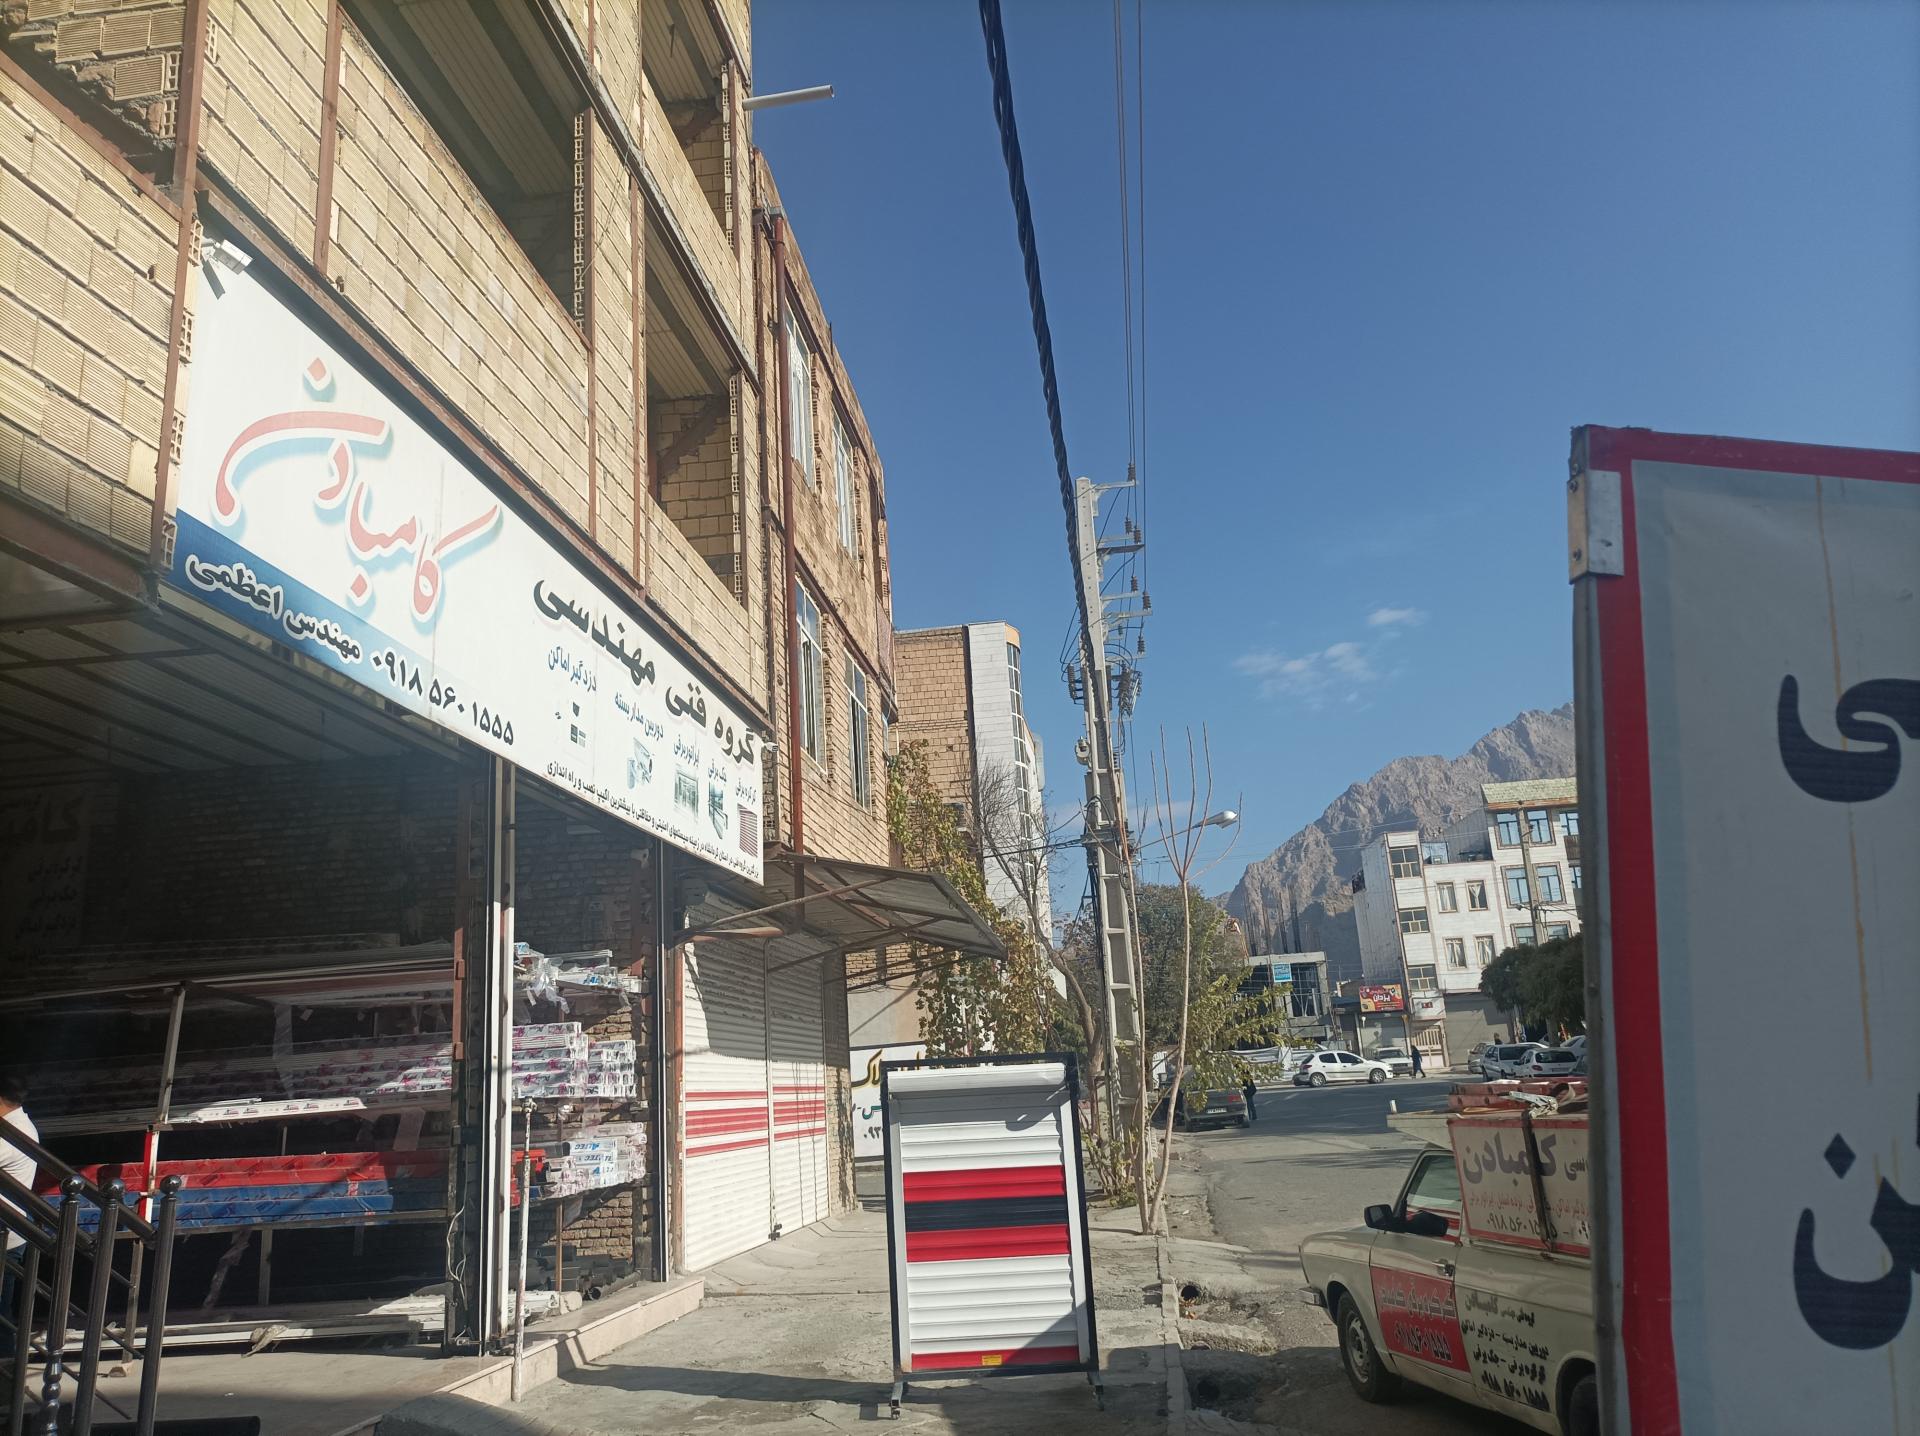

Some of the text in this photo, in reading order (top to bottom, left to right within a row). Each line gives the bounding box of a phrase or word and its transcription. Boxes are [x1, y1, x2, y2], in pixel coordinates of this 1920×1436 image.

[216, 357, 500, 616] کامبادن
[188, 560, 362, 661] مهندس اعظمی
[533, 580, 755, 765] گروه فنی مهندسی
[548, 646, 570, 673] اماکن
[644, 719, 664, 741] دوربین
[547, 761, 568, 778] اندازی
[583, 782, 596, 795] نصب
